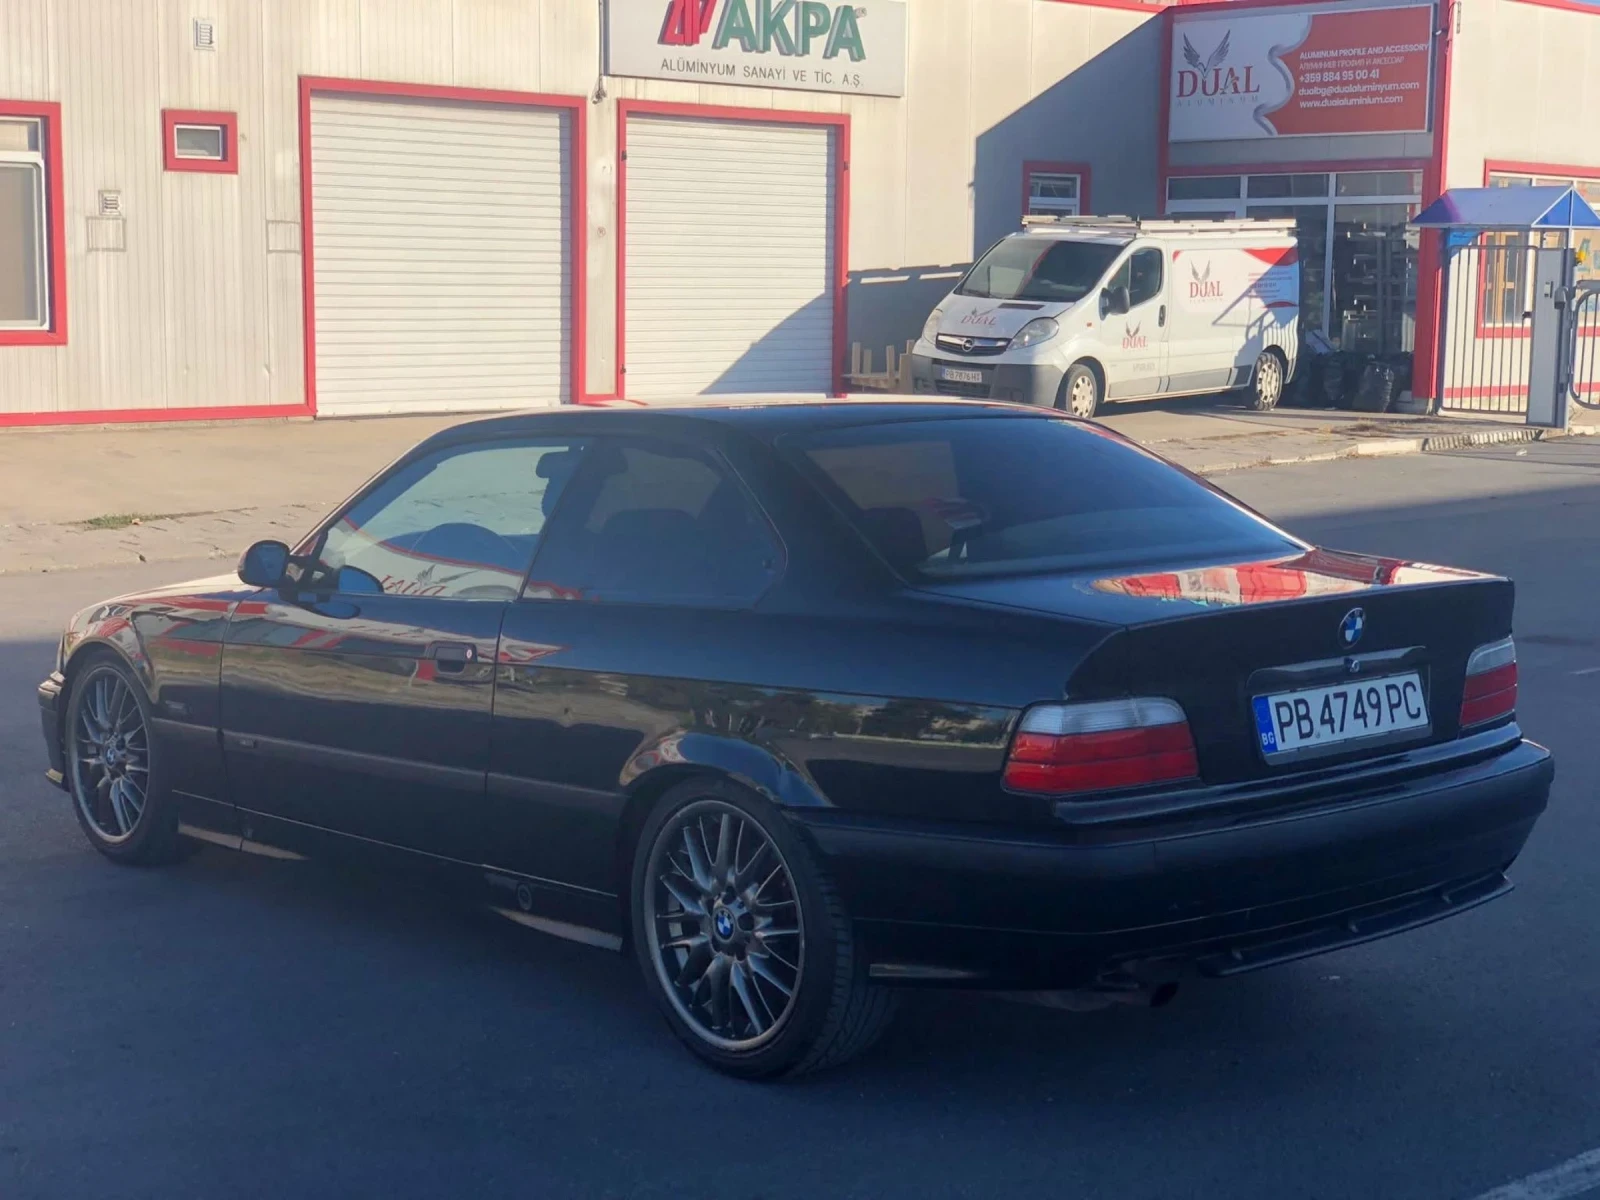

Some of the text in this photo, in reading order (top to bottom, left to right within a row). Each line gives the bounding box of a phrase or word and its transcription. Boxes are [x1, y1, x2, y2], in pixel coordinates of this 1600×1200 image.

[712, 0, 866, 62] AKPA
[1300, 43, 1429, 60] ALUMINUM PROFILE AND ACCESSORY
[661, 58, 864, 88] ALÜMİNYUM SANAYİ VE TİC. A.Ş.
[1299, 68, 1380, 83] +359 884 95 00 41
[1176, 66, 1260, 98] DUAL
[1189, 281, 1223, 298] DUAL
[961, 315, 996, 326] DUAL
[1123, 336, 1148, 349] DUAL
[1275, 681, 1421, 743] PB4749PC
[1262, 732, 1275, 746] BG
